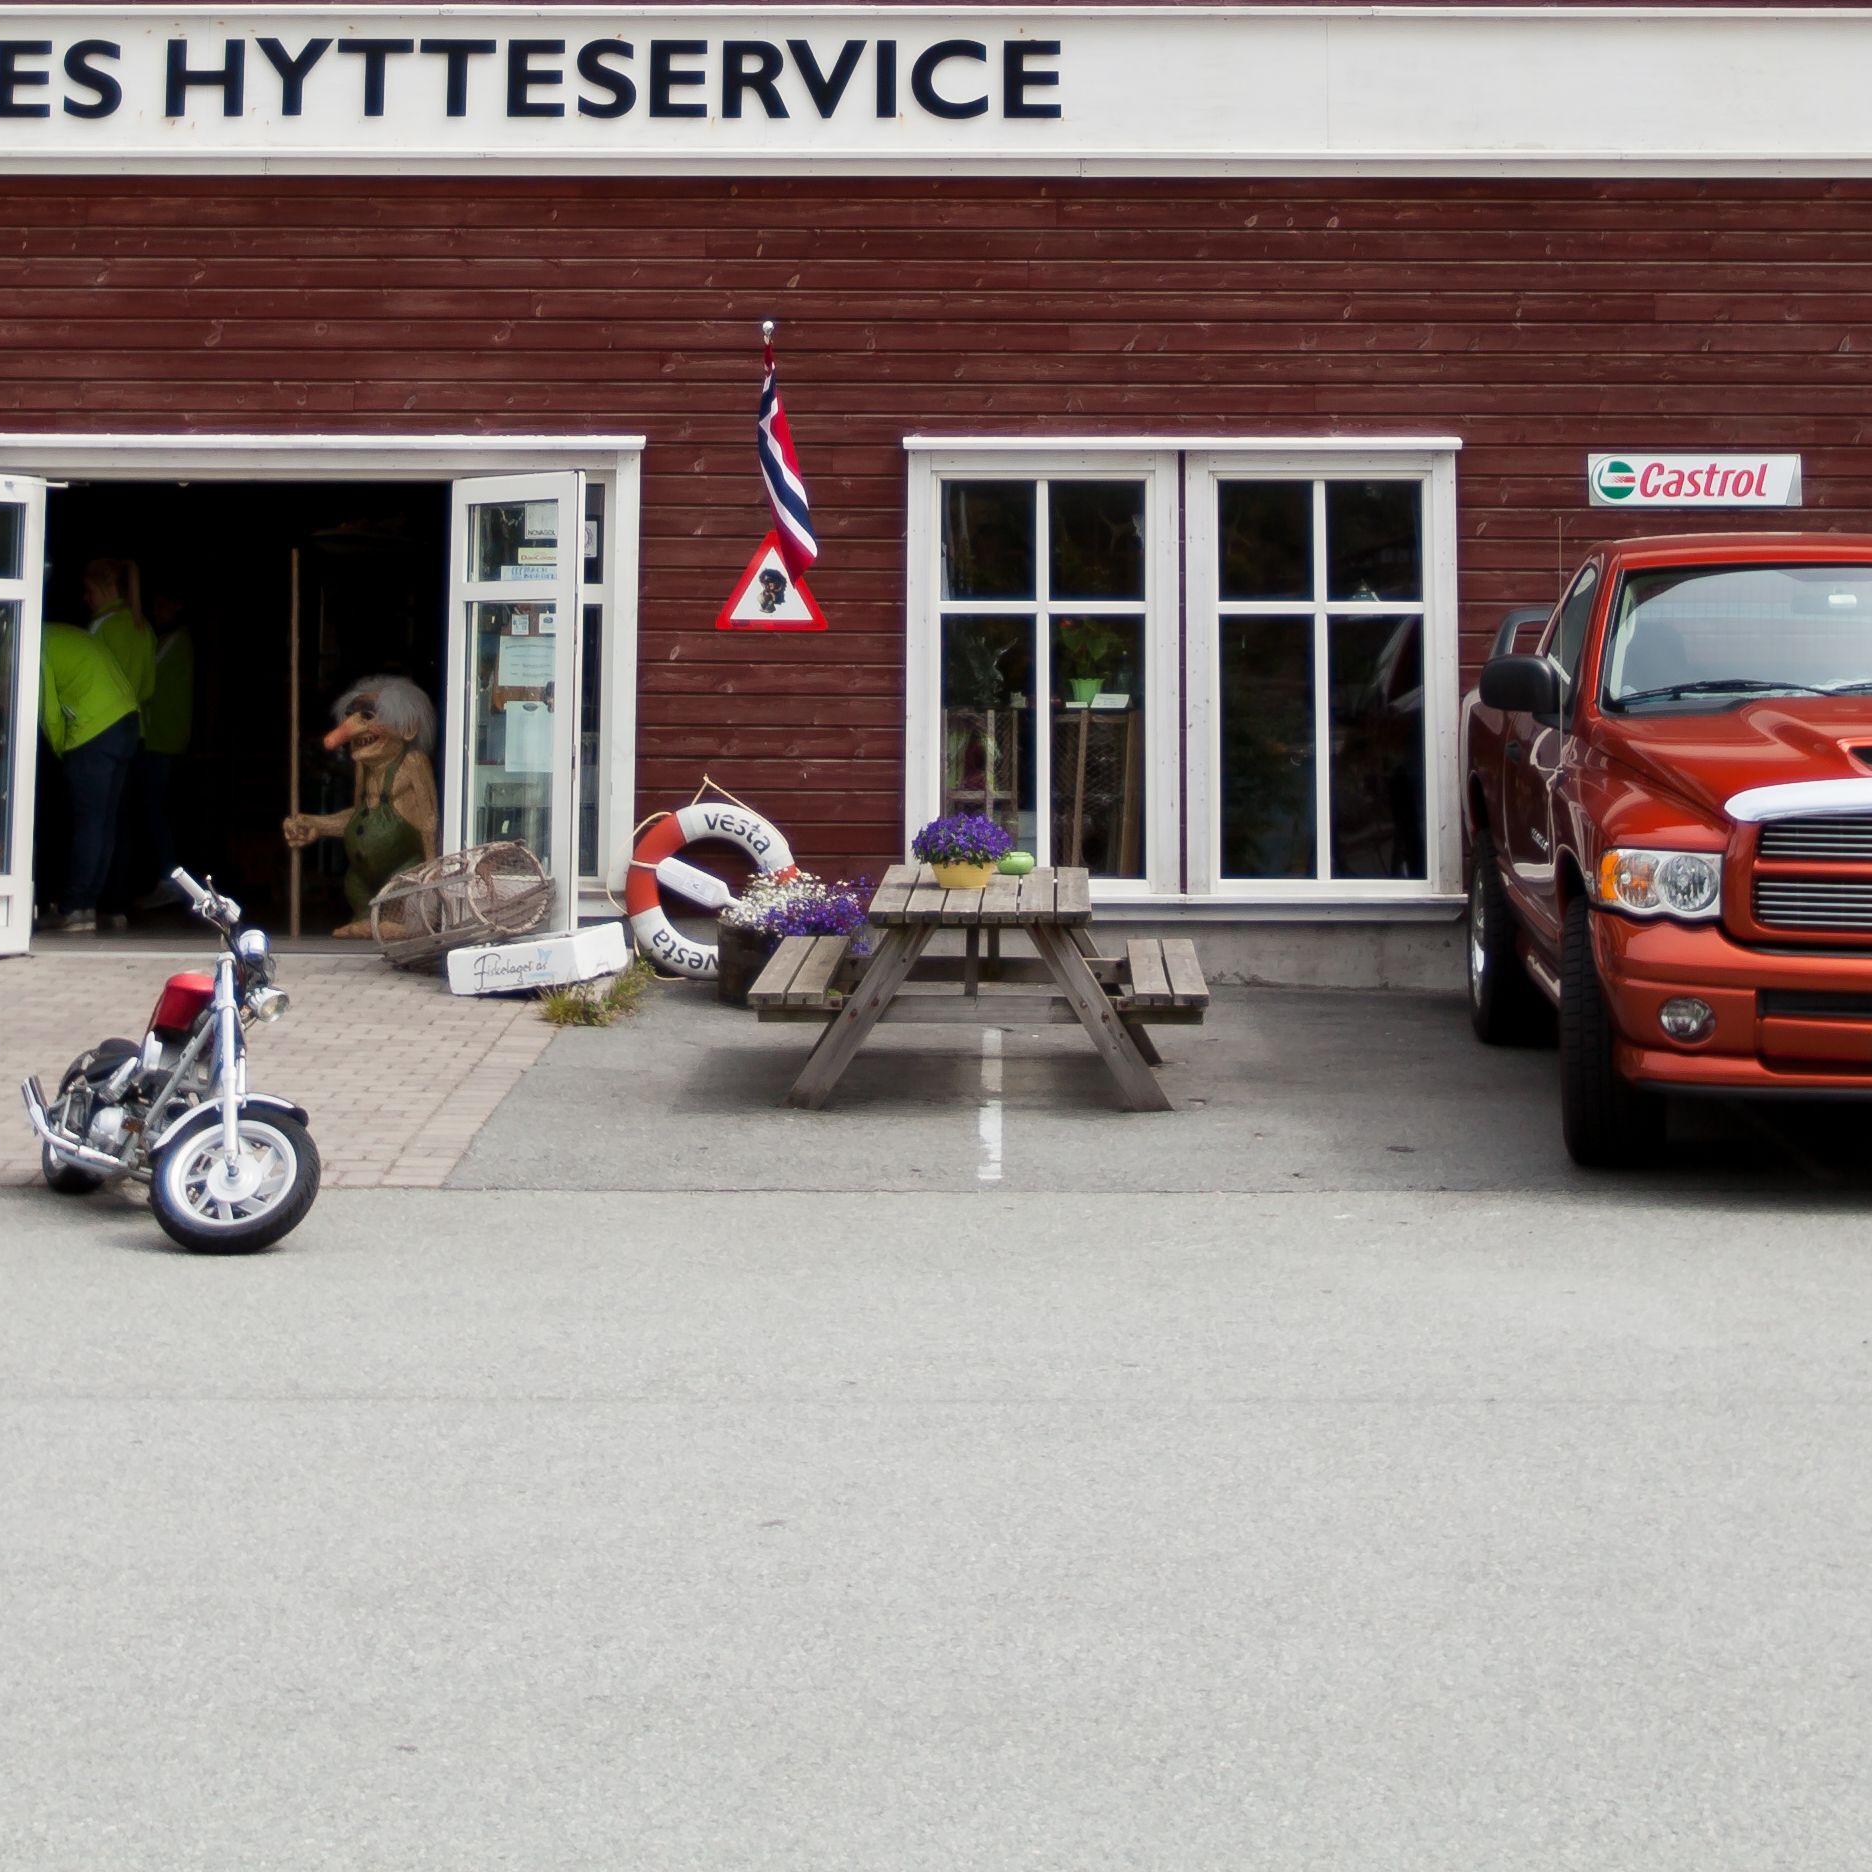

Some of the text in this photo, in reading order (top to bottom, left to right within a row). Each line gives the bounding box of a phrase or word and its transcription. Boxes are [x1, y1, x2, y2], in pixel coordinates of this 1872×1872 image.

[164, 37, 1062, 121] HYTTESERVICE
[1639, 462, 1769, 498] Castrol
[703, 812, 772, 856] vesta
